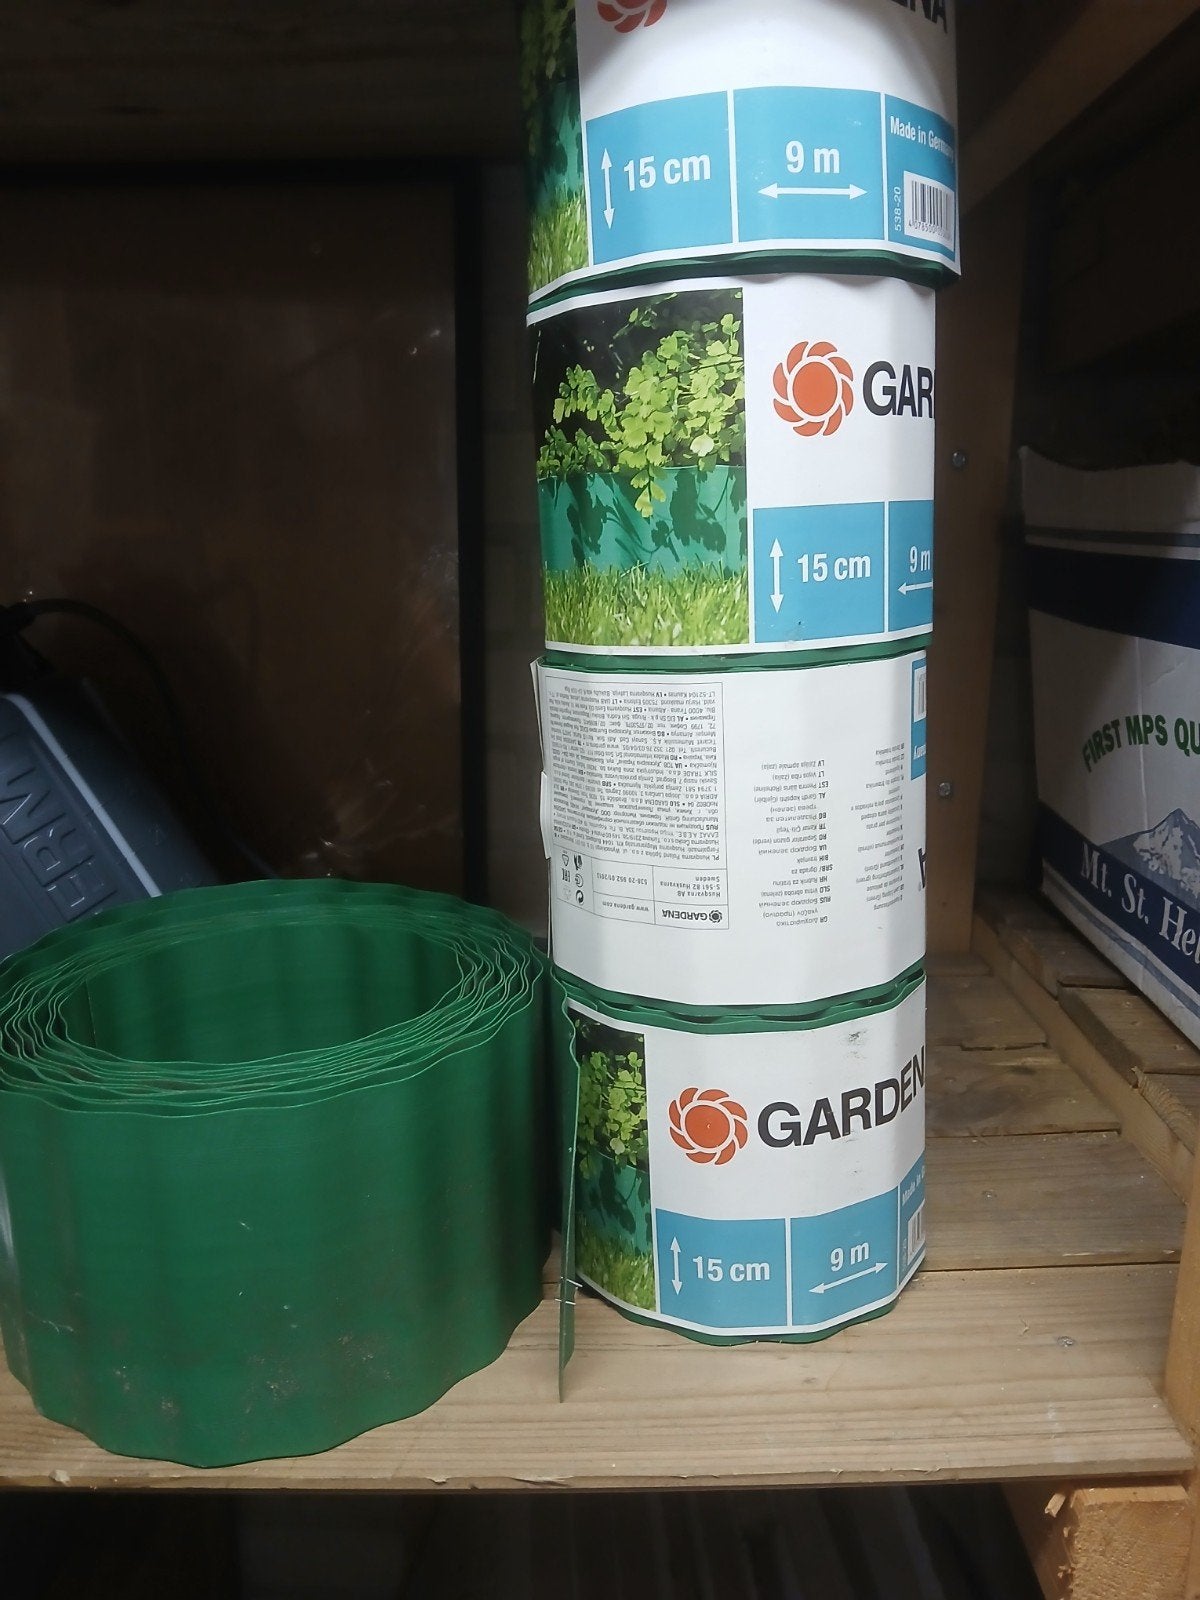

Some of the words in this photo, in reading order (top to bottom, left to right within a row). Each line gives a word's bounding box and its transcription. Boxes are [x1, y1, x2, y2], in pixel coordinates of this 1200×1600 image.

[890, 116, 916, 141] Made
[918, 126, 927, 145] in
[624, 156, 656, 192] 15
[663, 154, 711, 186] cm
[785, 140, 805, 173] 9
[813, 147, 840, 174] m
[893, 186, 902, 231] 538-20
[862, 360, 935, 420] GAR
[797, 553, 828, 583] 15
[834, 555, 871, 580] cm
[909, 546, 918, 573] 9
[920, 549, 931, 572] m
[1081, 718, 1122, 774] FIRST
[1125, 714, 1168, 747] MPS
[1174, 717, 1200, 757] QU
[0, 757, 118, 924] ERM
[1080, 841, 1112, 898] Mt.
[1121, 874, 1150, 925] St.
[662, 910, 708, 920] GARDENA
[757, 1045, 925, 1148] GARDEN
[693, 1256, 723, 1282] 15
[730, 1261, 770, 1282] cm
[830, 1247, 844, 1272] 9
[851, 1242, 870, 1264] m
